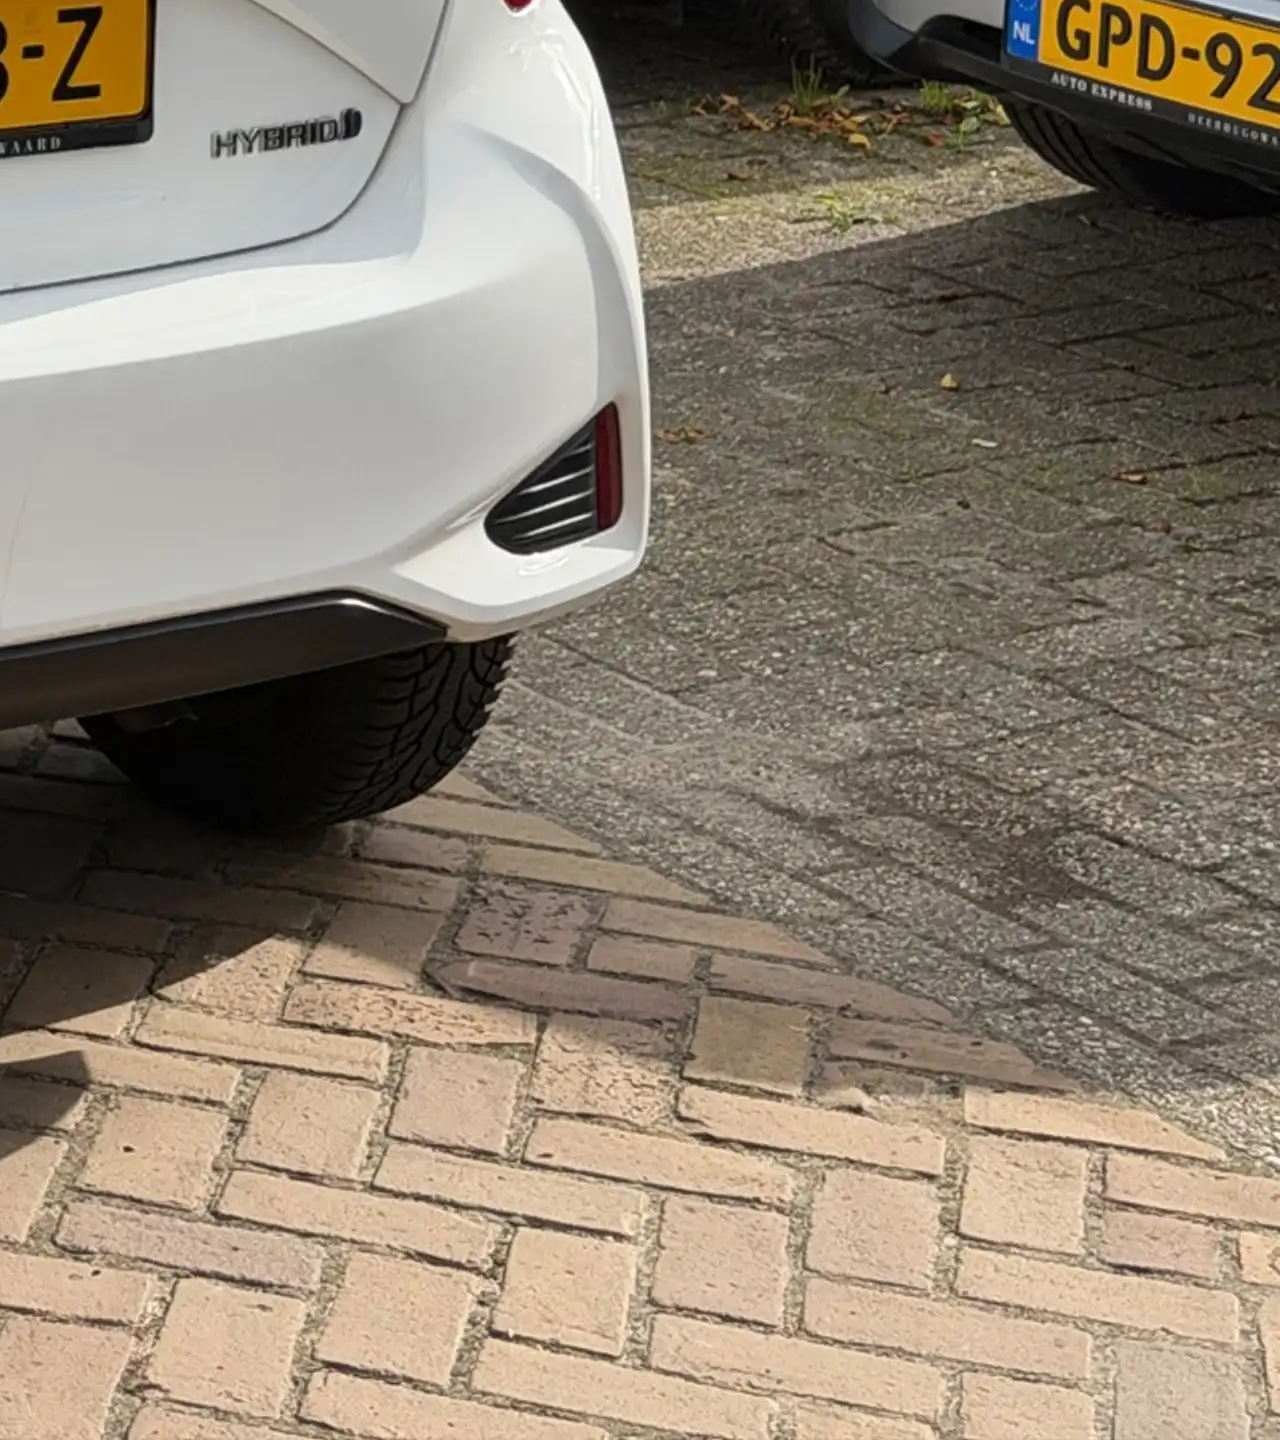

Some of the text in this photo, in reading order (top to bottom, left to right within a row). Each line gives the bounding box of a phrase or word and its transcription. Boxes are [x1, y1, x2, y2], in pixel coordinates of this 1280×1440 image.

[1011, 19, 1036, 46] NL
[1050, 71, 1088, 93] AUTO
[1091, 83, 1153, 111] EXPRESS
[209, 116, 339, 160] HYBRID
